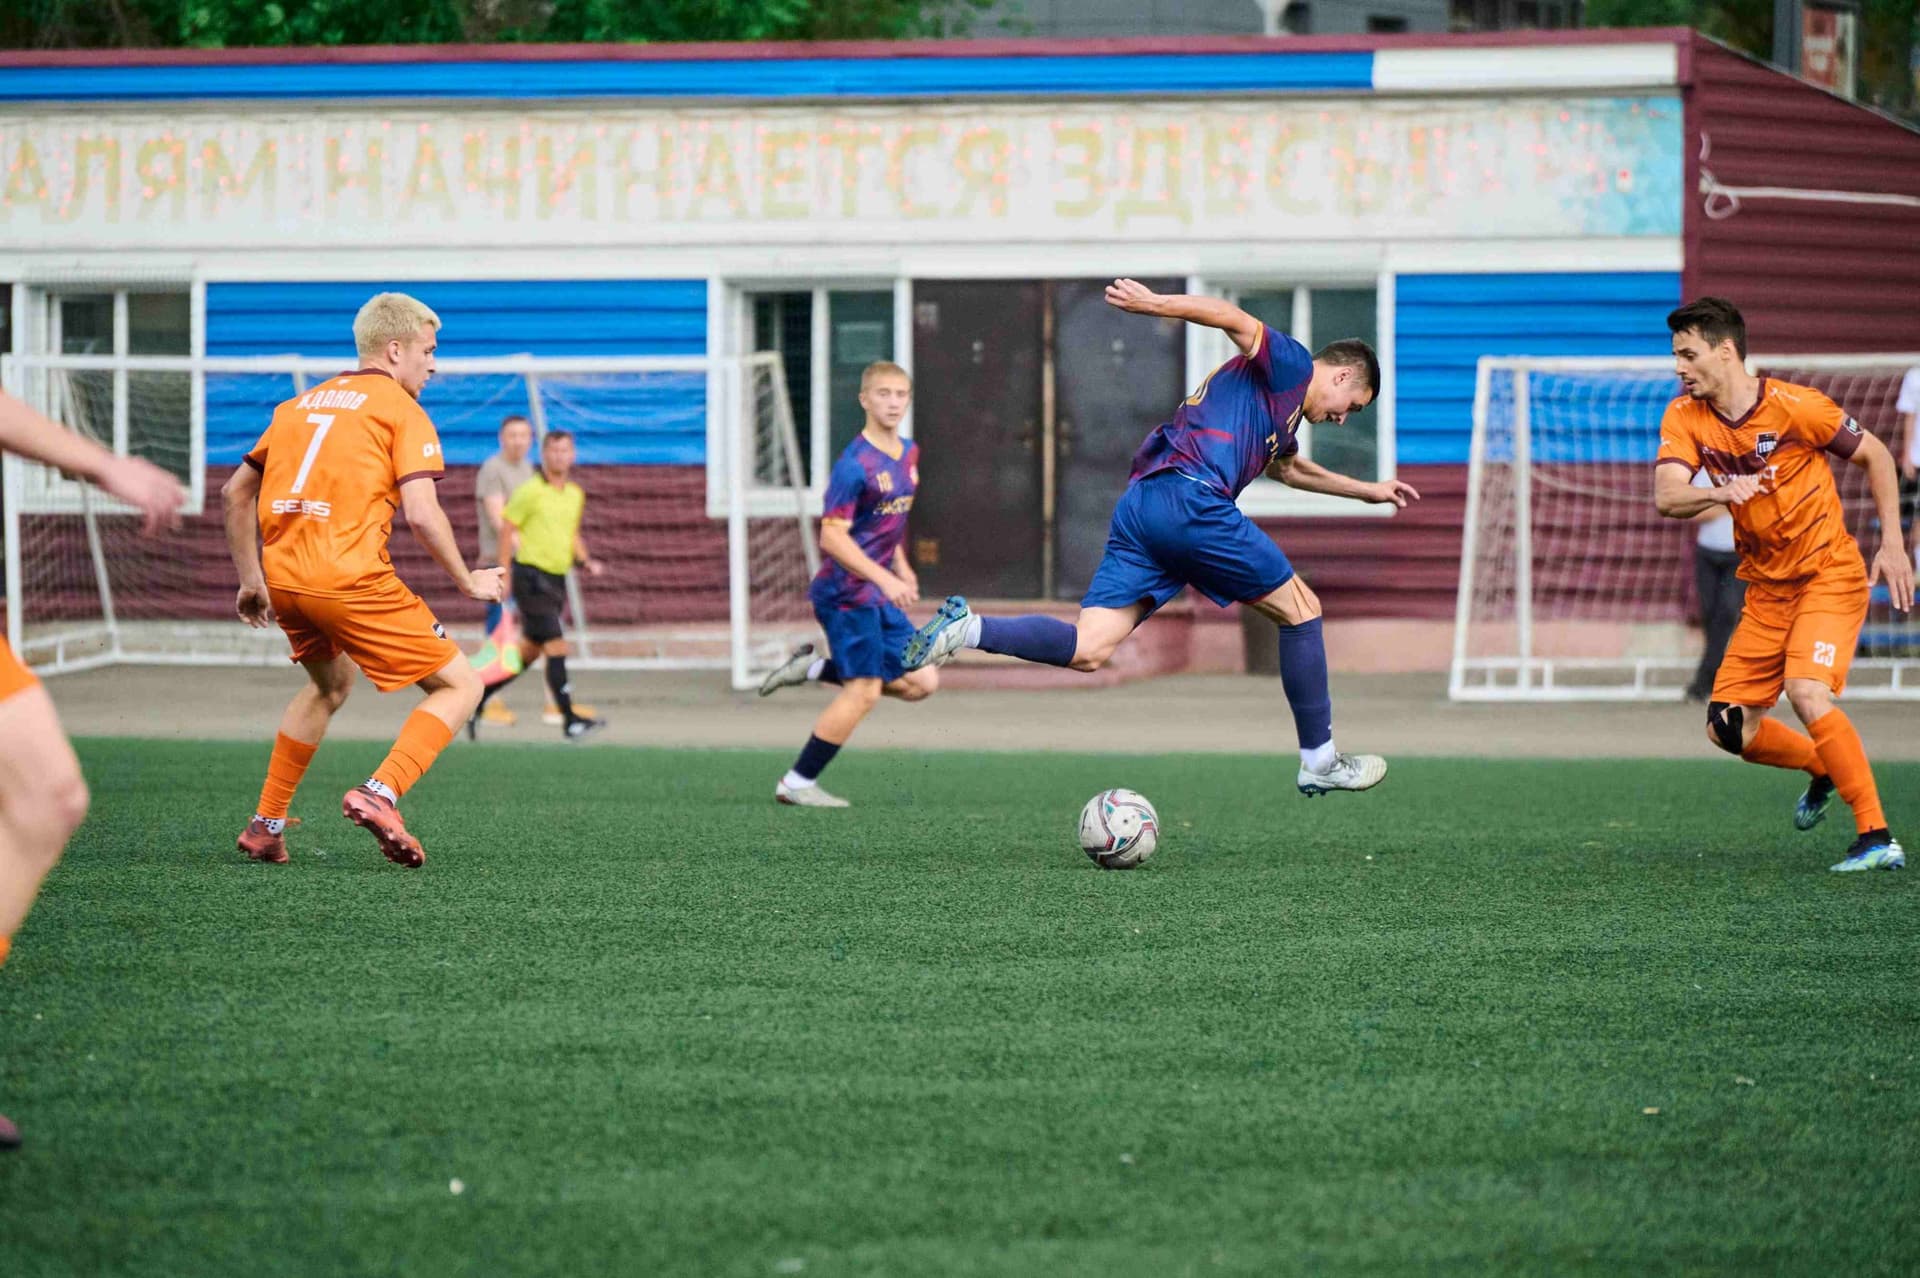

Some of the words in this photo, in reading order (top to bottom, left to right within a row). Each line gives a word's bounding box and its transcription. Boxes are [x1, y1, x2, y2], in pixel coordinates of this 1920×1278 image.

[323, 130, 1009, 222] НАЧИНАЕТСЯ
[290, 413, 336, 494] 7
[1812, 640, 1837, 667] 23
